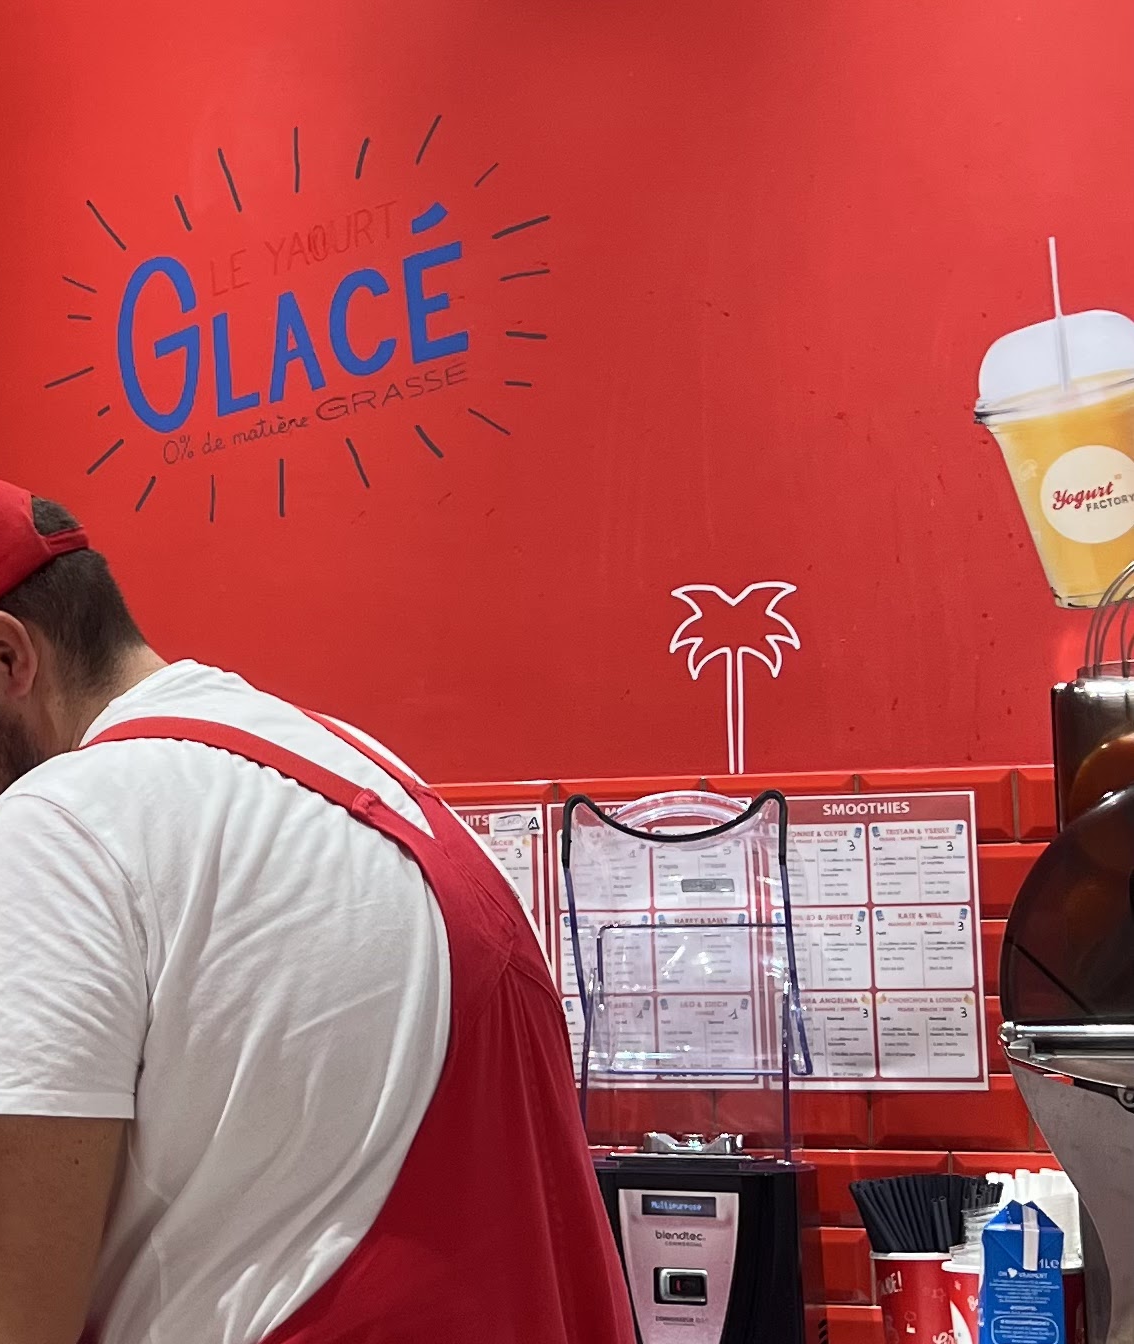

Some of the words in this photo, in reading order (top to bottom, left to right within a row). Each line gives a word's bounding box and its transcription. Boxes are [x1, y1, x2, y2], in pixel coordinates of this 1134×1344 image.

[210, 249, 249, 297] LE
[264, 201, 399, 275] YAOURT
[117, 202, 469, 434] GLACÉ
[162, 434, 196, 466] 0%
[201, 431, 227, 455] de
[232, 414, 310, 446] matière
[315, 362, 468, 422] GRASSE
[1052, 481, 1114, 511] Yogurt
[1085, 493, 1134, 513] FACTORY
[822, 801, 911, 817] SMOOTHIES
[847, 839, 856, 852] 3
[946, 840, 954, 852] 3
[514, 848, 523, 859] 3
[855, 924, 862, 936] 3
[957, 921, 965, 932] 3
[862, 1008, 869, 1019] 3
[959, 1006, 968, 1018] 3
